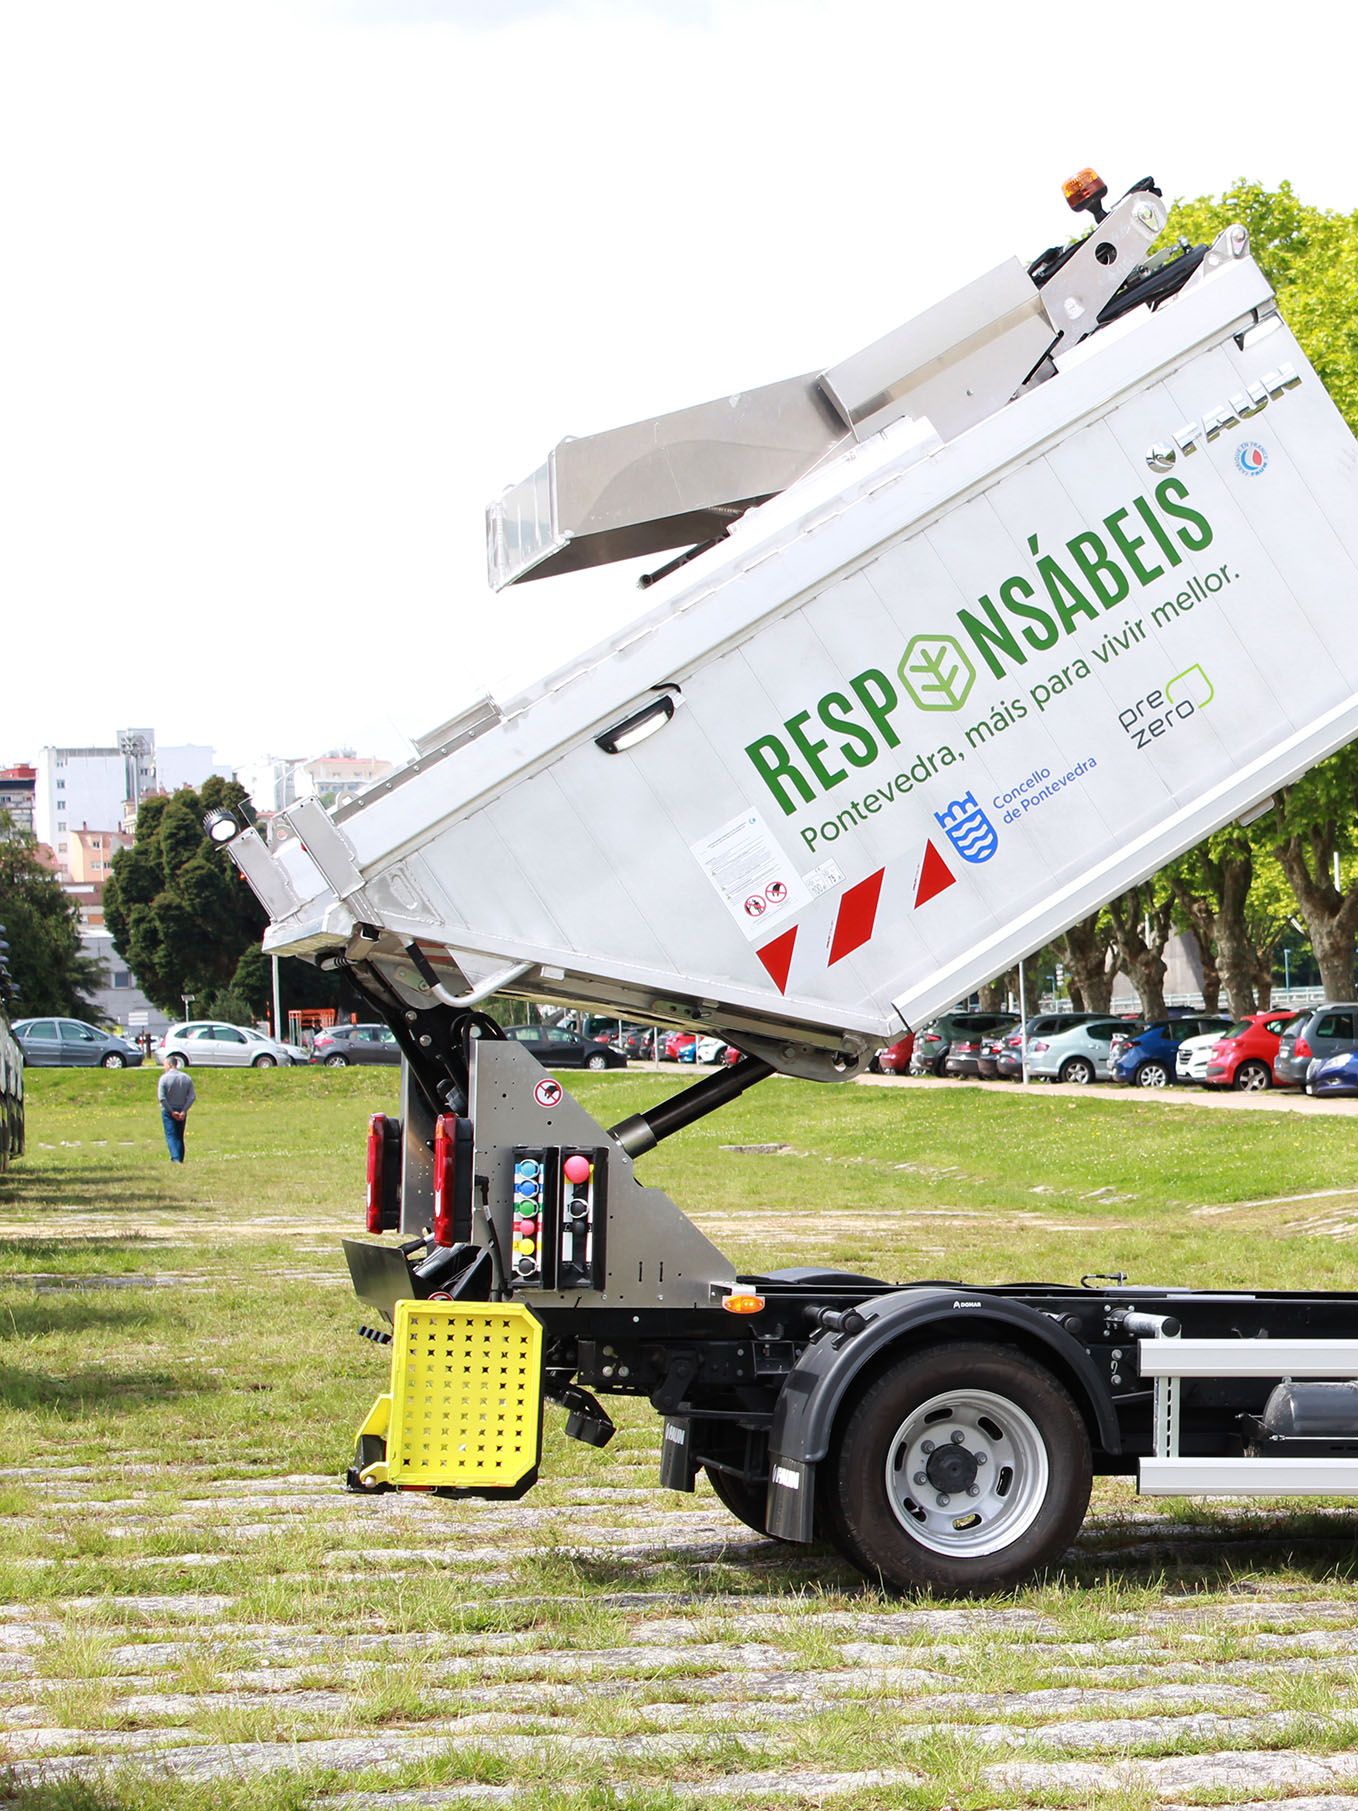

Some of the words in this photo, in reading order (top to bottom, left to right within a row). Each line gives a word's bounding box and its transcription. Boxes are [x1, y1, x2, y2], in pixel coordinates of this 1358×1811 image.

[800, 746, 966, 854] Pontevedra,
[963, 700, 1028, 750] máis
[1029, 659, 1091, 713] para
[1091, 619, 1146, 665] vivir
[1151, 564, 1240, 629] mellor.
[1118, 689, 1164, 734] pre
[1129, 699, 1195, 750] zero
[992, 767, 1052, 809] Concello
[1002, 809, 1022, 824] de
[1020, 757, 1097, 812] Pontevedra
